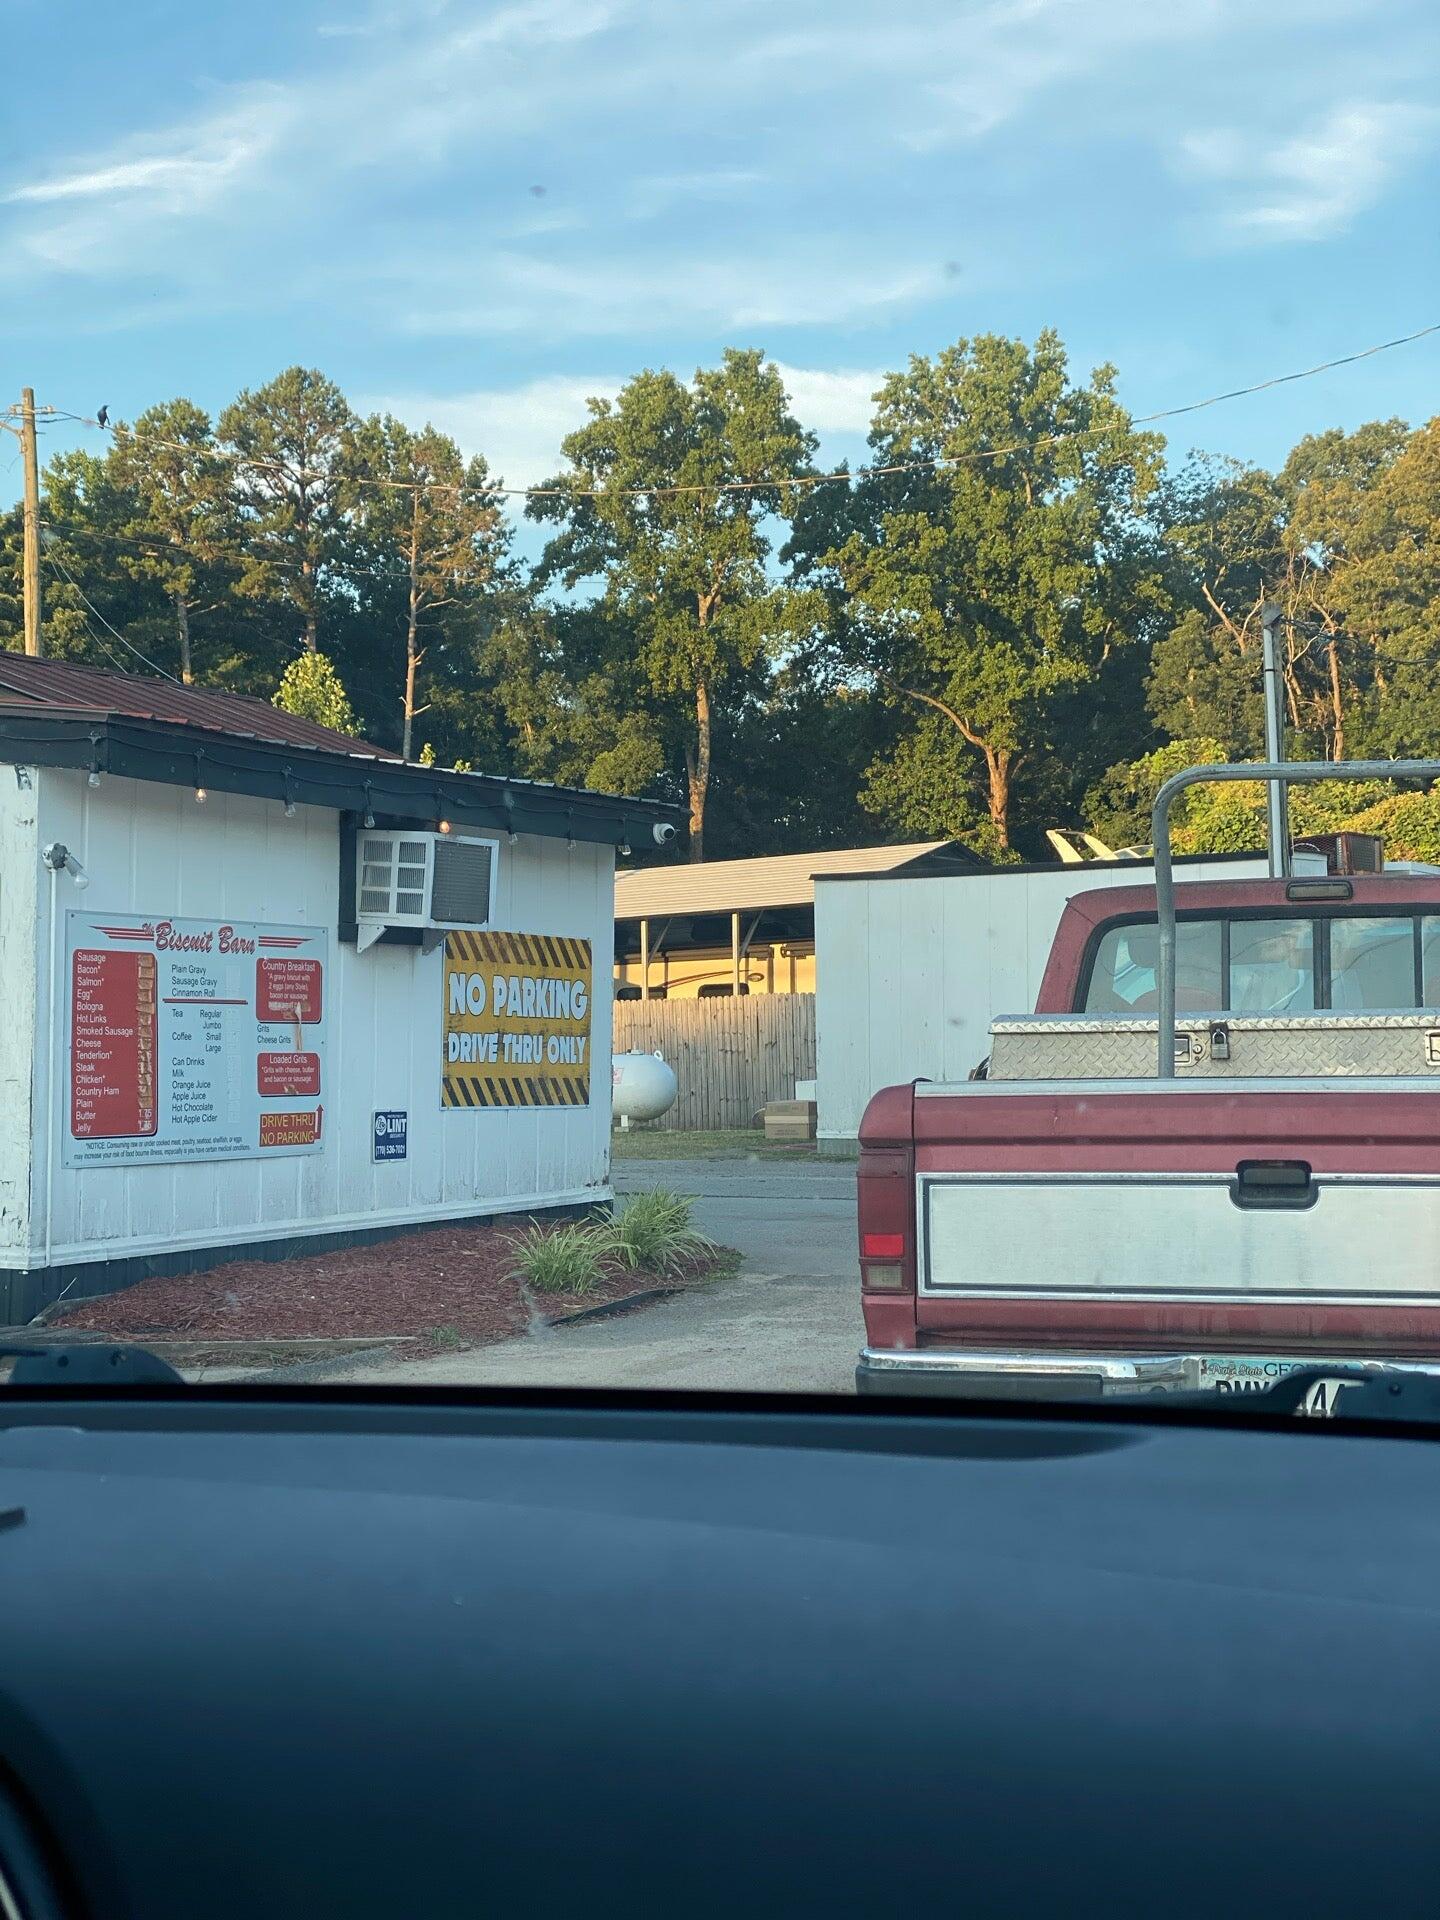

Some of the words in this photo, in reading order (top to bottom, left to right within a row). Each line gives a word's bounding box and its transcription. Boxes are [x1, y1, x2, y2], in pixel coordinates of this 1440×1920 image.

[155, 921, 213, 952] Biscuit
[218, 925, 256, 955] Barn
[77, 952, 106, 963] Sausage
[171, 964, 187, 973] Plain
[188, 965, 206, 976] Gravy
[262, 961, 286, 972] Country
[287, 962, 315, 971] Breakfast
[171, 976, 198, 987] Sausage
[200, 977, 218, 988] Gravy
[171, 988, 202, 997] Cinnamon
[204, 989, 215, 997] Roll
[448, 972, 487, 1016] NO
[492, 975, 588, 1020] PARKING
[77, 1002, 103, 1012] Bologna
[77, 1014, 88, 1022] Hot
[90, 1014, 107, 1023] Links
[172, 1008, 183, 1018] Tea
[200, 1009, 222, 1020] Regular
[77, 1026, 103, 1035] Smoked
[105, 1026, 133, 1037] Sausage
[257, 1024, 269, 1032] Grits
[172, 1031, 192, 1040] Coffee
[206, 1032, 221, 1040] Small
[257, 1035, 277, 1044] Cheese
[279, 1036, 291, 1044] Grits
[76, 1038, 101, 1048] Cheese
[206, 1044, 222, 1054] Large
[448, 1032, 498, 1064] DRIVE
[502, 1033, 543, 1064] THRU
[547, 1035, 587, 1065] ONLY
[172, 1057, 185, 1066] Can
[186, 1057, 205, 1066] Drinks
[270, 1054, 291, 1064] Loaded
[293, 1054, 307, 1064] Grits
[76, 1062, 95, 1072] Steak
[172, 1069, 184, 1078] Milk
[172, 1080, 194, 1090] Orange
[196, 1080, 211, 1088] Juice
[76, 1087, 103, 1098] Country
[103, 1086, 120, 1095] Ham
[172, 1092, 189, 1102] Apple
[190, 1092, 206, 1100] Juice
[76, 1099, 93, 1108] Plain
[172, 1104, 183, 1112] Hot
[184, 1103, 213, 1112] Chocolate
[76, 1111, 96, 1120] Butter
[172, 1115, 183, 1124] Hot
[184, 1115, 200, 1125] Apple
[202, 1114, 218, 1122] Cider
[261, 1116, 288, 1128] DRIVE
[290, 1114, 314, 1126] THRU
[387, 1118, 407, 1133] LINT
[76, 1123, 91, 1133] Jelly
[261, 1132, 274, 1145] NO
[277, 1131, 314, 1144] PARKING
